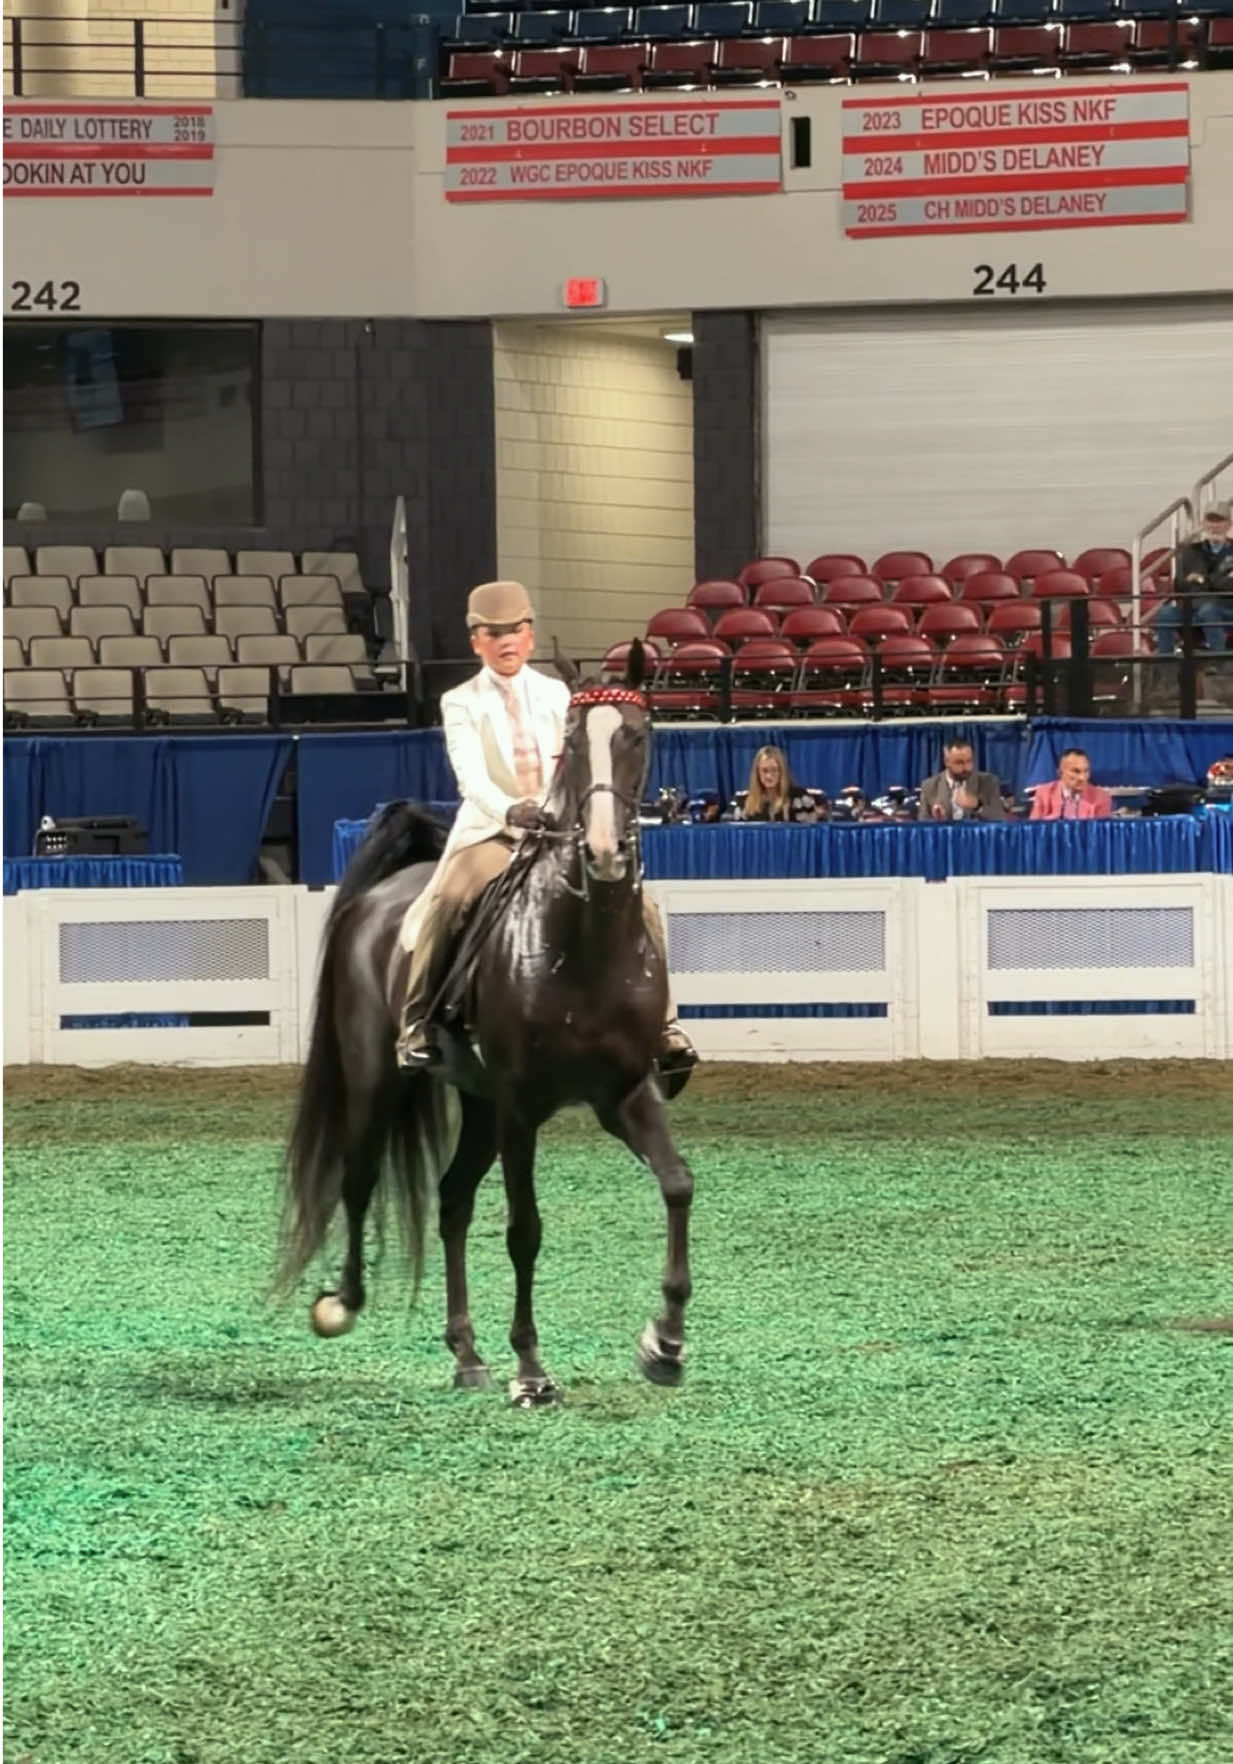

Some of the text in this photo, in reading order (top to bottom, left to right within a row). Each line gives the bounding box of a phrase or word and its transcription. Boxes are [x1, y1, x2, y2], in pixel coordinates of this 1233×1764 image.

[21, 118, 66, 138] DAILY
[75, 118, 152, 139] LOTTERY
[460, 113, 719, 141] 2021 BOURBON SELECT
[863, 99, 1117, 130] 2023 EPOQUE KISS NKF
[70, 163, 96, 184] AT
[101, 163, 145, 184] YOU
[460, 160, 712, 185] 2022 WGC EPOQUE KISS NKF
[864, 145, 1105, 176] 2024 MIDD'S DELANEY
[857, 193, 1108, 223] 2025 CH MIDD'S DELANEY
[973, 263, 1047, 295] 244
[11, 280, 81, 311] 242
